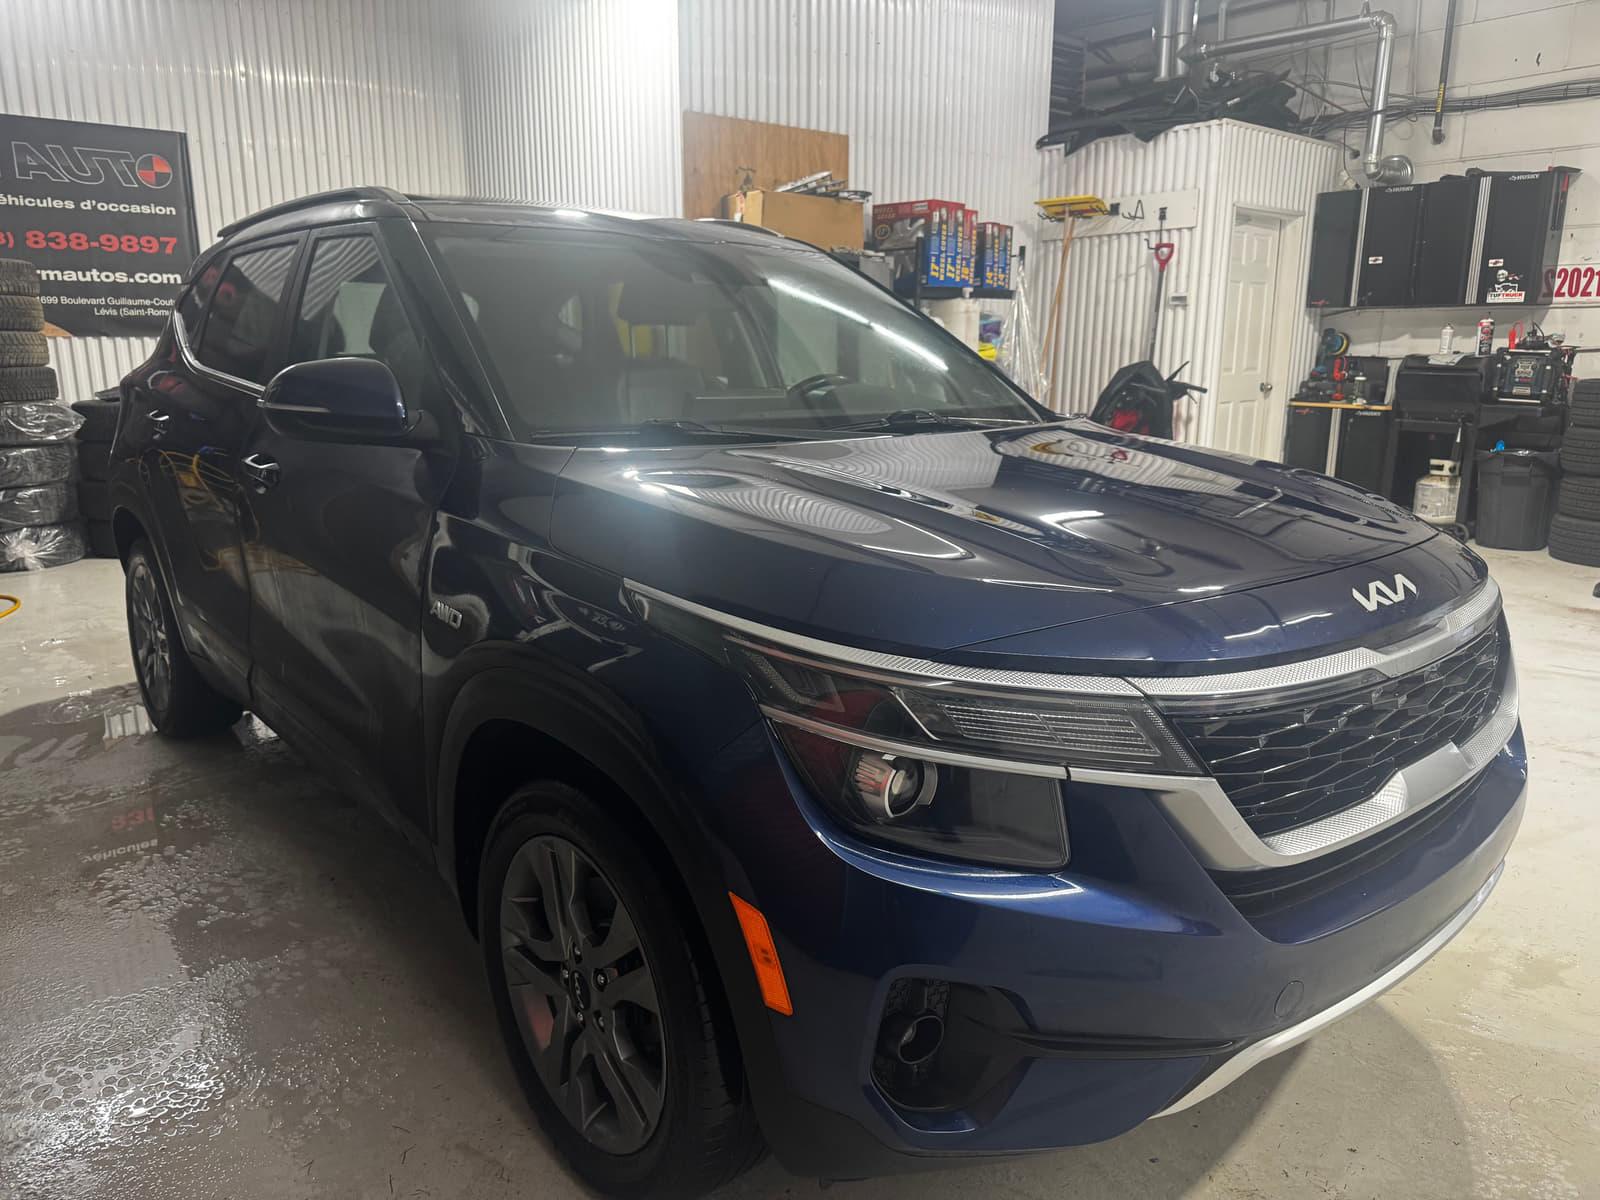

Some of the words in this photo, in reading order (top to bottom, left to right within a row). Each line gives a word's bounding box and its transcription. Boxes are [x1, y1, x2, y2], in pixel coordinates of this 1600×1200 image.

[80, 199, 176, 215] d'occasion
[25, 230, 177, 255] 838-9897
[36, 268, 182, 284] mautos.com
[37, 296, 58, 305] 699
[60, 296, 105, 305] Boulevard
[94, 307, 118, 316] Lévis
[430, 600, 463, 630] AWD
